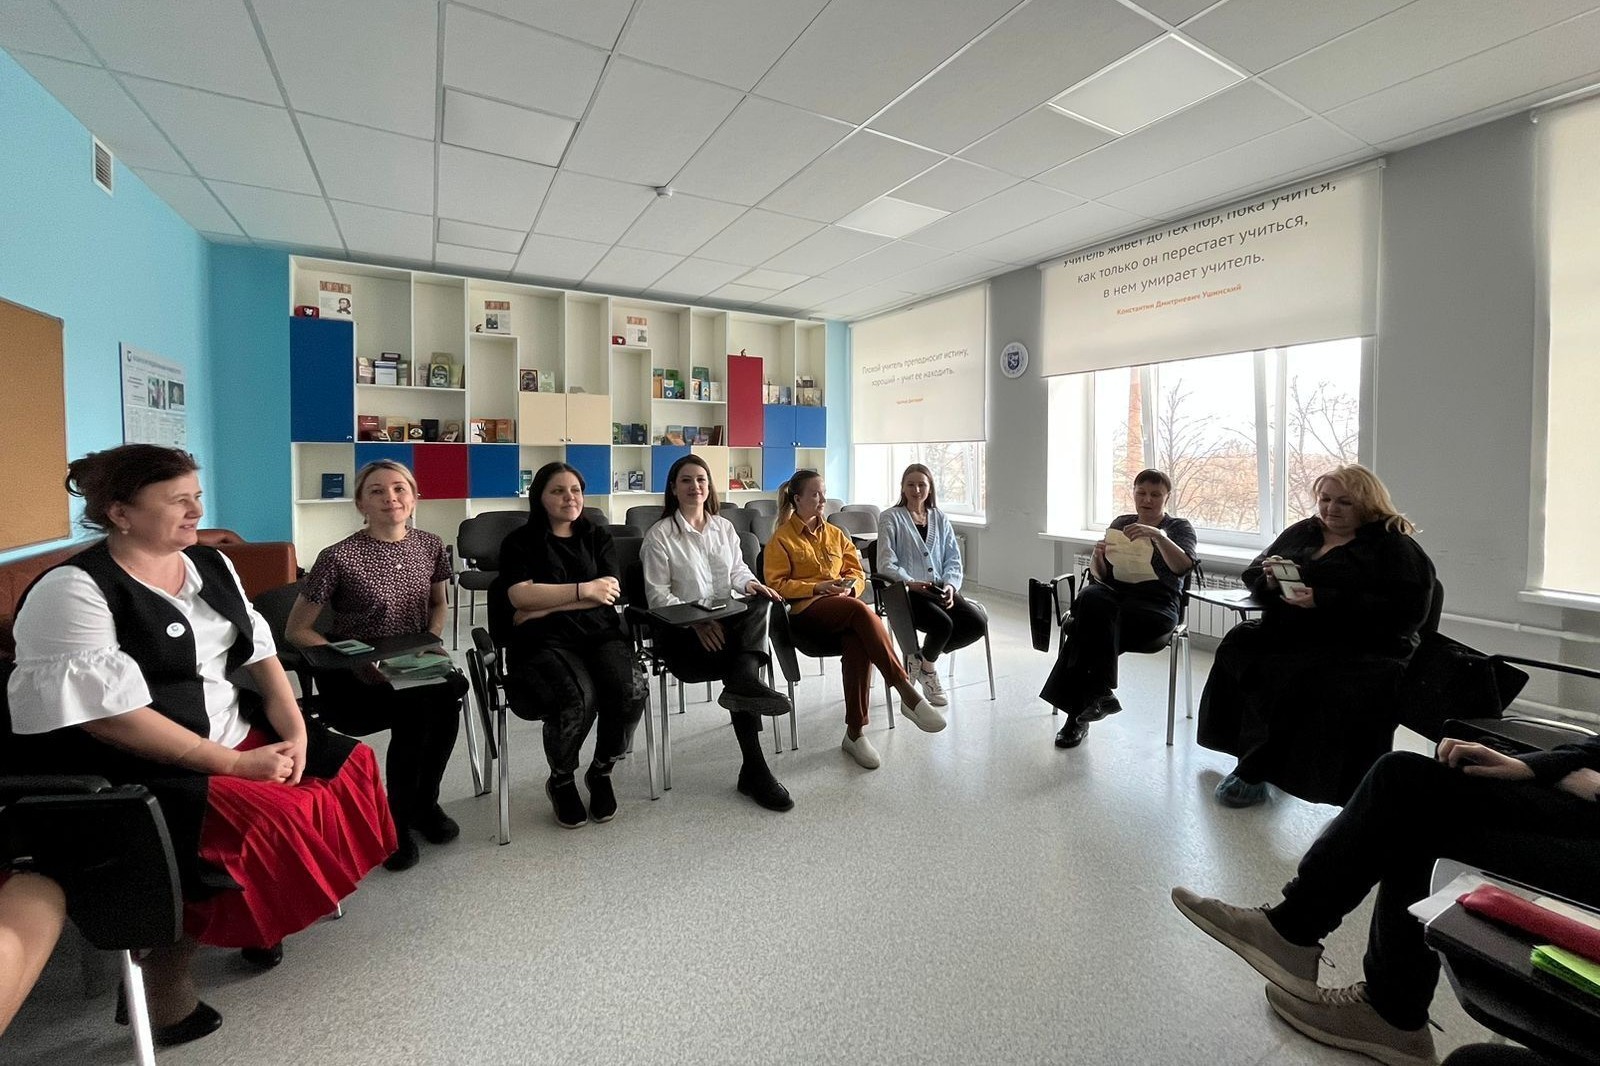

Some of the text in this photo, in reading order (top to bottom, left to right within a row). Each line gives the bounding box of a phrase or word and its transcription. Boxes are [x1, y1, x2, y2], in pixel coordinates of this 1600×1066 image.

[1146, 232, 1163, 246] до
[1168, 225, 1189, 237] тех
[1227, 202, 1265, 220] пока
[1272, 182, 1336, 210] учится,
[1077, 215, 1308, 284] как только он перестает учиться,
[1103, 254, 1265, 298] в нем умирает учитель.
[1116, 283, 1242, 316] Константин Дмитриевич Ушинский
